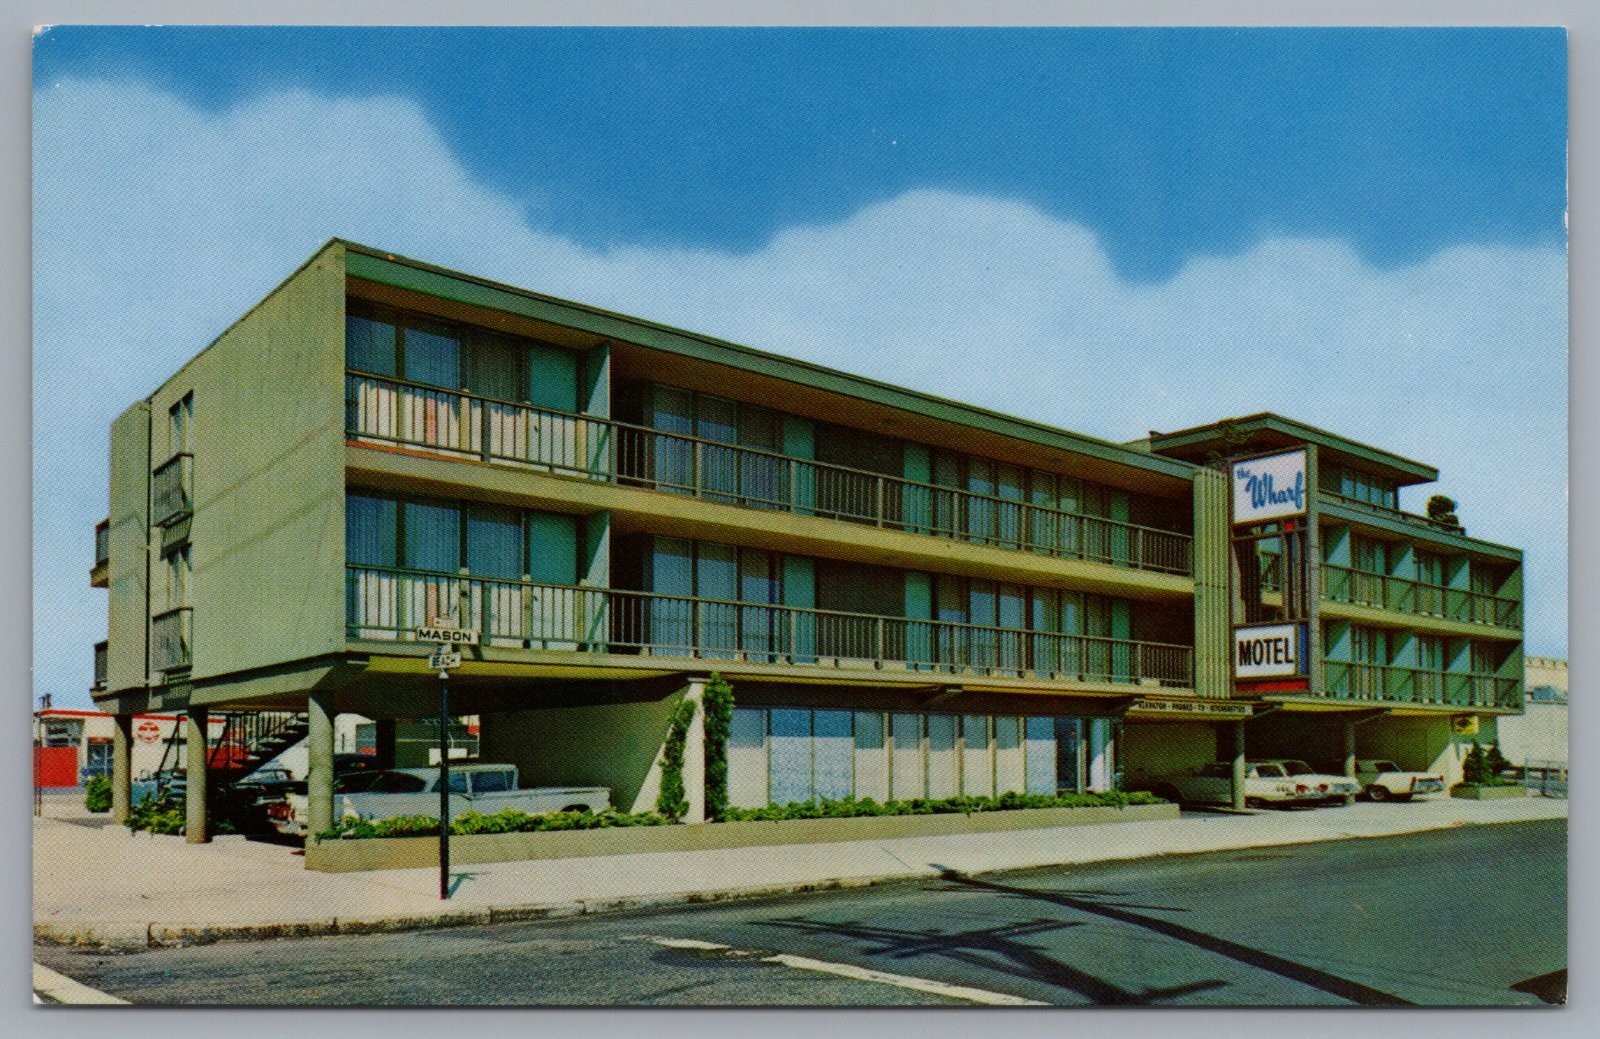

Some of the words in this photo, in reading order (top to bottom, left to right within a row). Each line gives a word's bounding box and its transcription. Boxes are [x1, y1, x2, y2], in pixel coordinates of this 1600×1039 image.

[1236, 467, 1250, 479] the
[1245, 470, 1304, 509] Wharf
[418, 629, 472, 642] MASON
[1238, 637, 1294, 667] MOTEL
